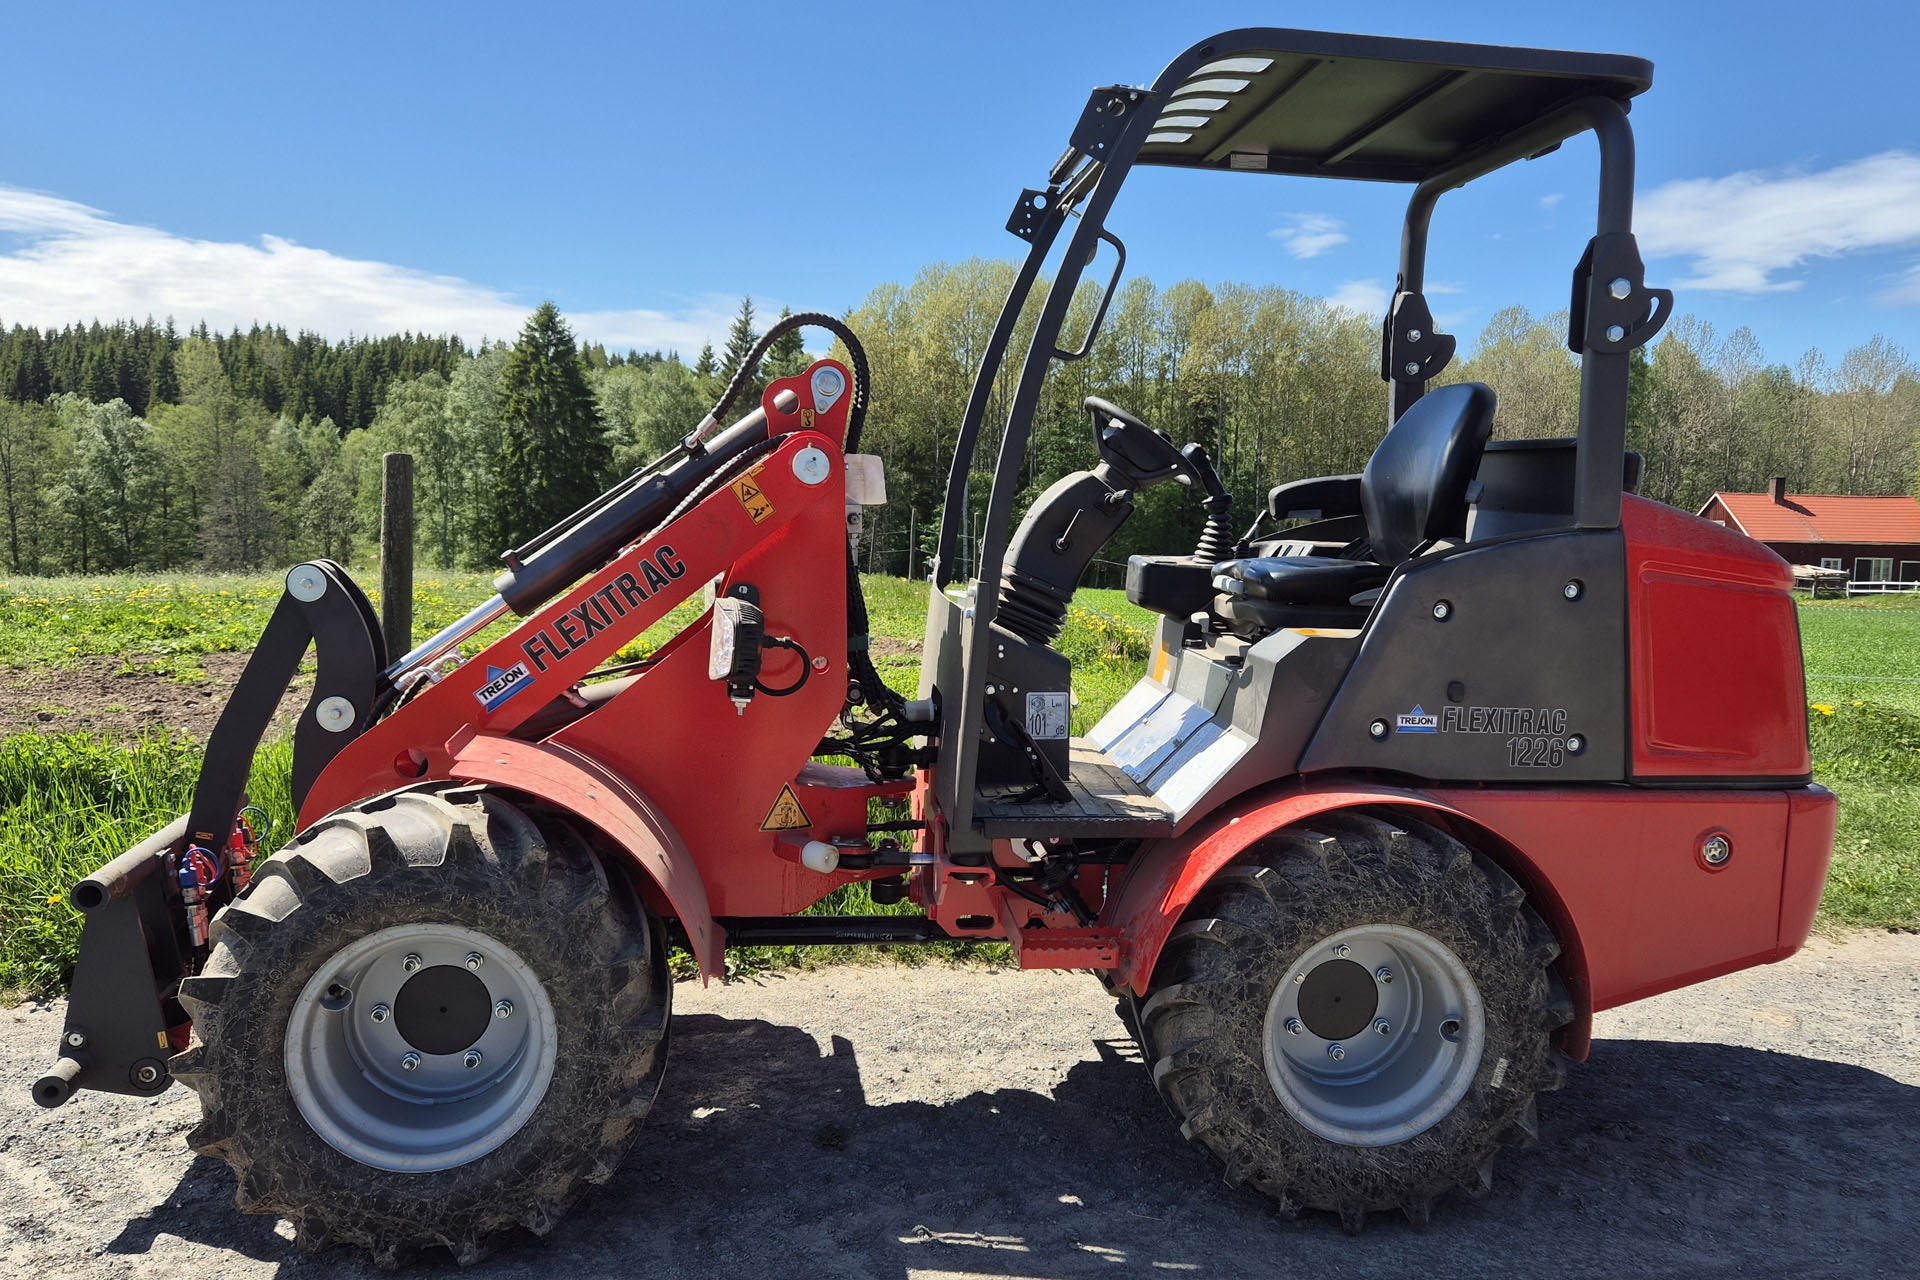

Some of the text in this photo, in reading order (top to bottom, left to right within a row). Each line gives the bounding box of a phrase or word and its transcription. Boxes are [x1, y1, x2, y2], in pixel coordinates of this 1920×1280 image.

[478, 544, 687, 700] TREJON FLEXITRAC
[1029, 713, 1047, 735] 101
[1399, 706, 1566, 735] TREJON FLEXITRAC
[1507, 737, 1565, 768] 1226
